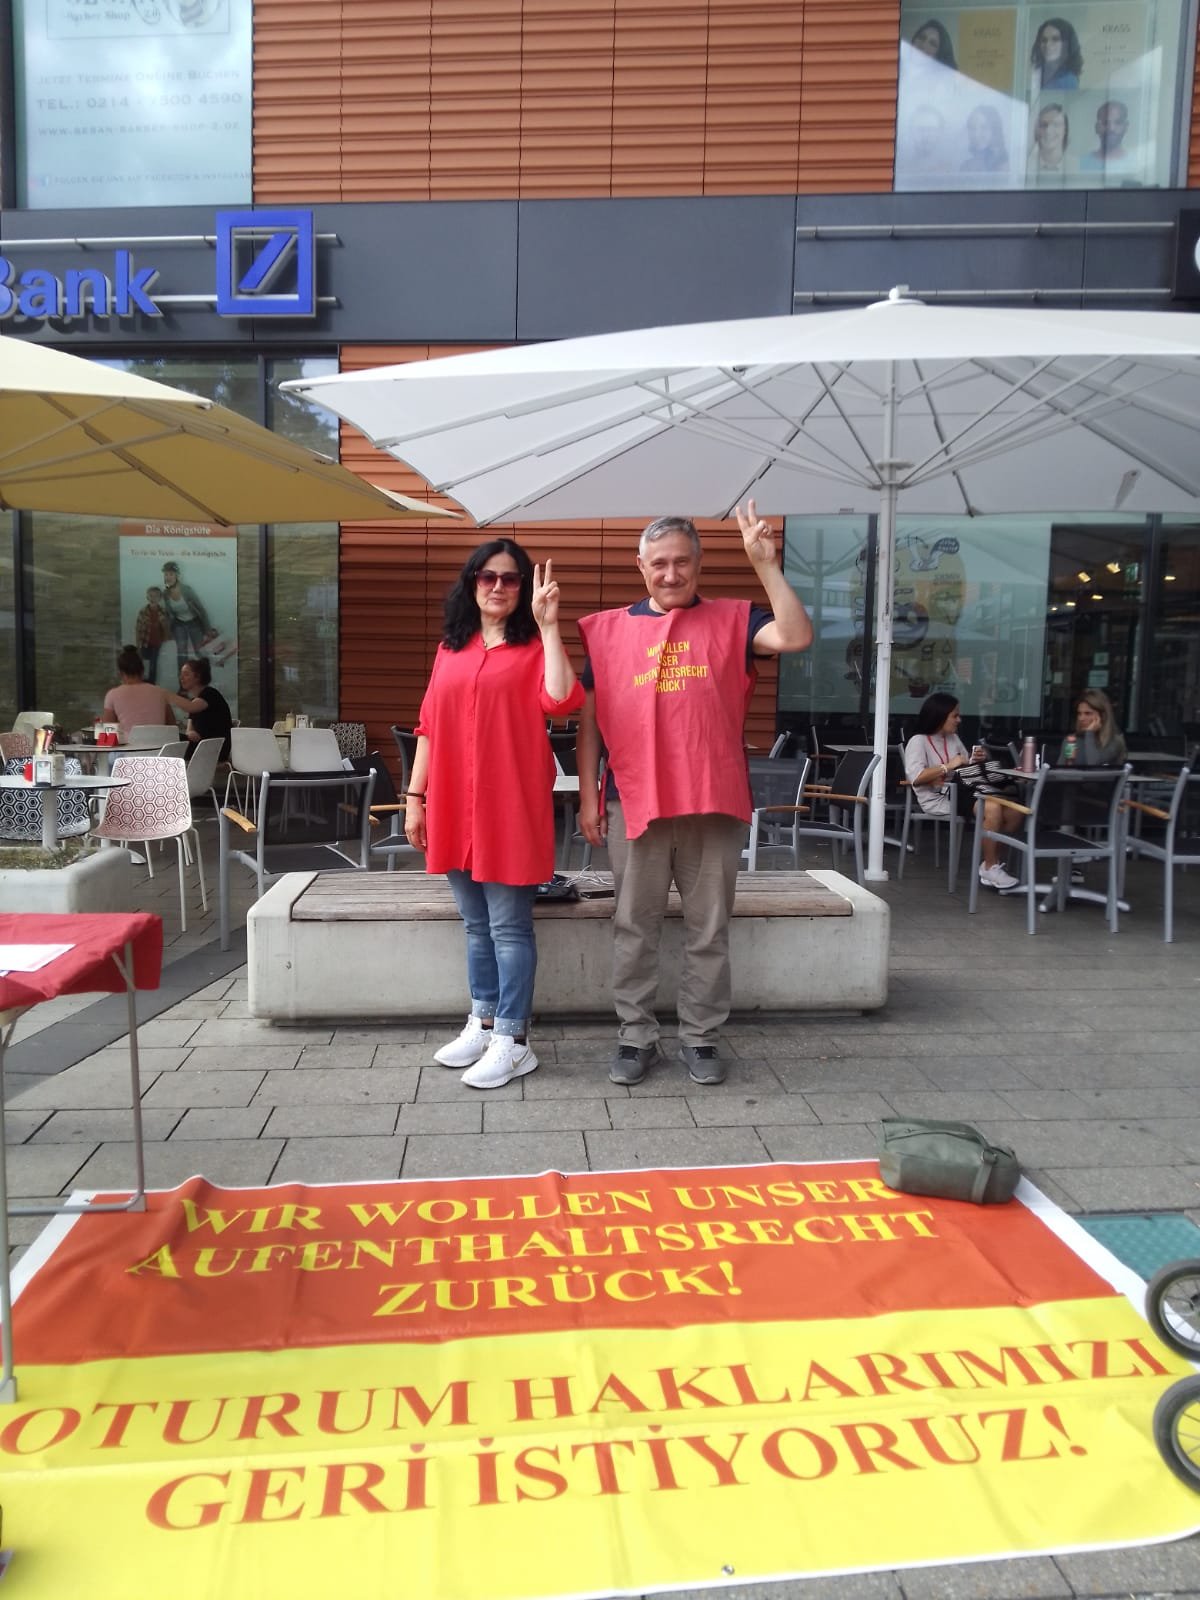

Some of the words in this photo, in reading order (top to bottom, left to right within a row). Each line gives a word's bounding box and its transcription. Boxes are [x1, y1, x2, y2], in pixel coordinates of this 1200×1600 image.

[1101, 23, 1131, 33] KRASS
[87, 96, 129, 109] 0214
[198, 91, 242, 105] 4590
[181, 1199, 322, 1235] WIR
[347, 1190, 652, 1226] WOLLEN
[673, 1178, 902, 1211] UNSER
[124, 1211, 938, 1279] AUFENTHALTSRECHT
[373, 1261, 743, 1316] ZURÜCK!
[0, 1380, 478, 1455] OTURUM
[508, 1338, 1175, 1423] HAKLARIMIZI
[145, 1442, 434, 1530] GERİ
[470, 1405, 1090, 1507] İSTİYORUZ!
